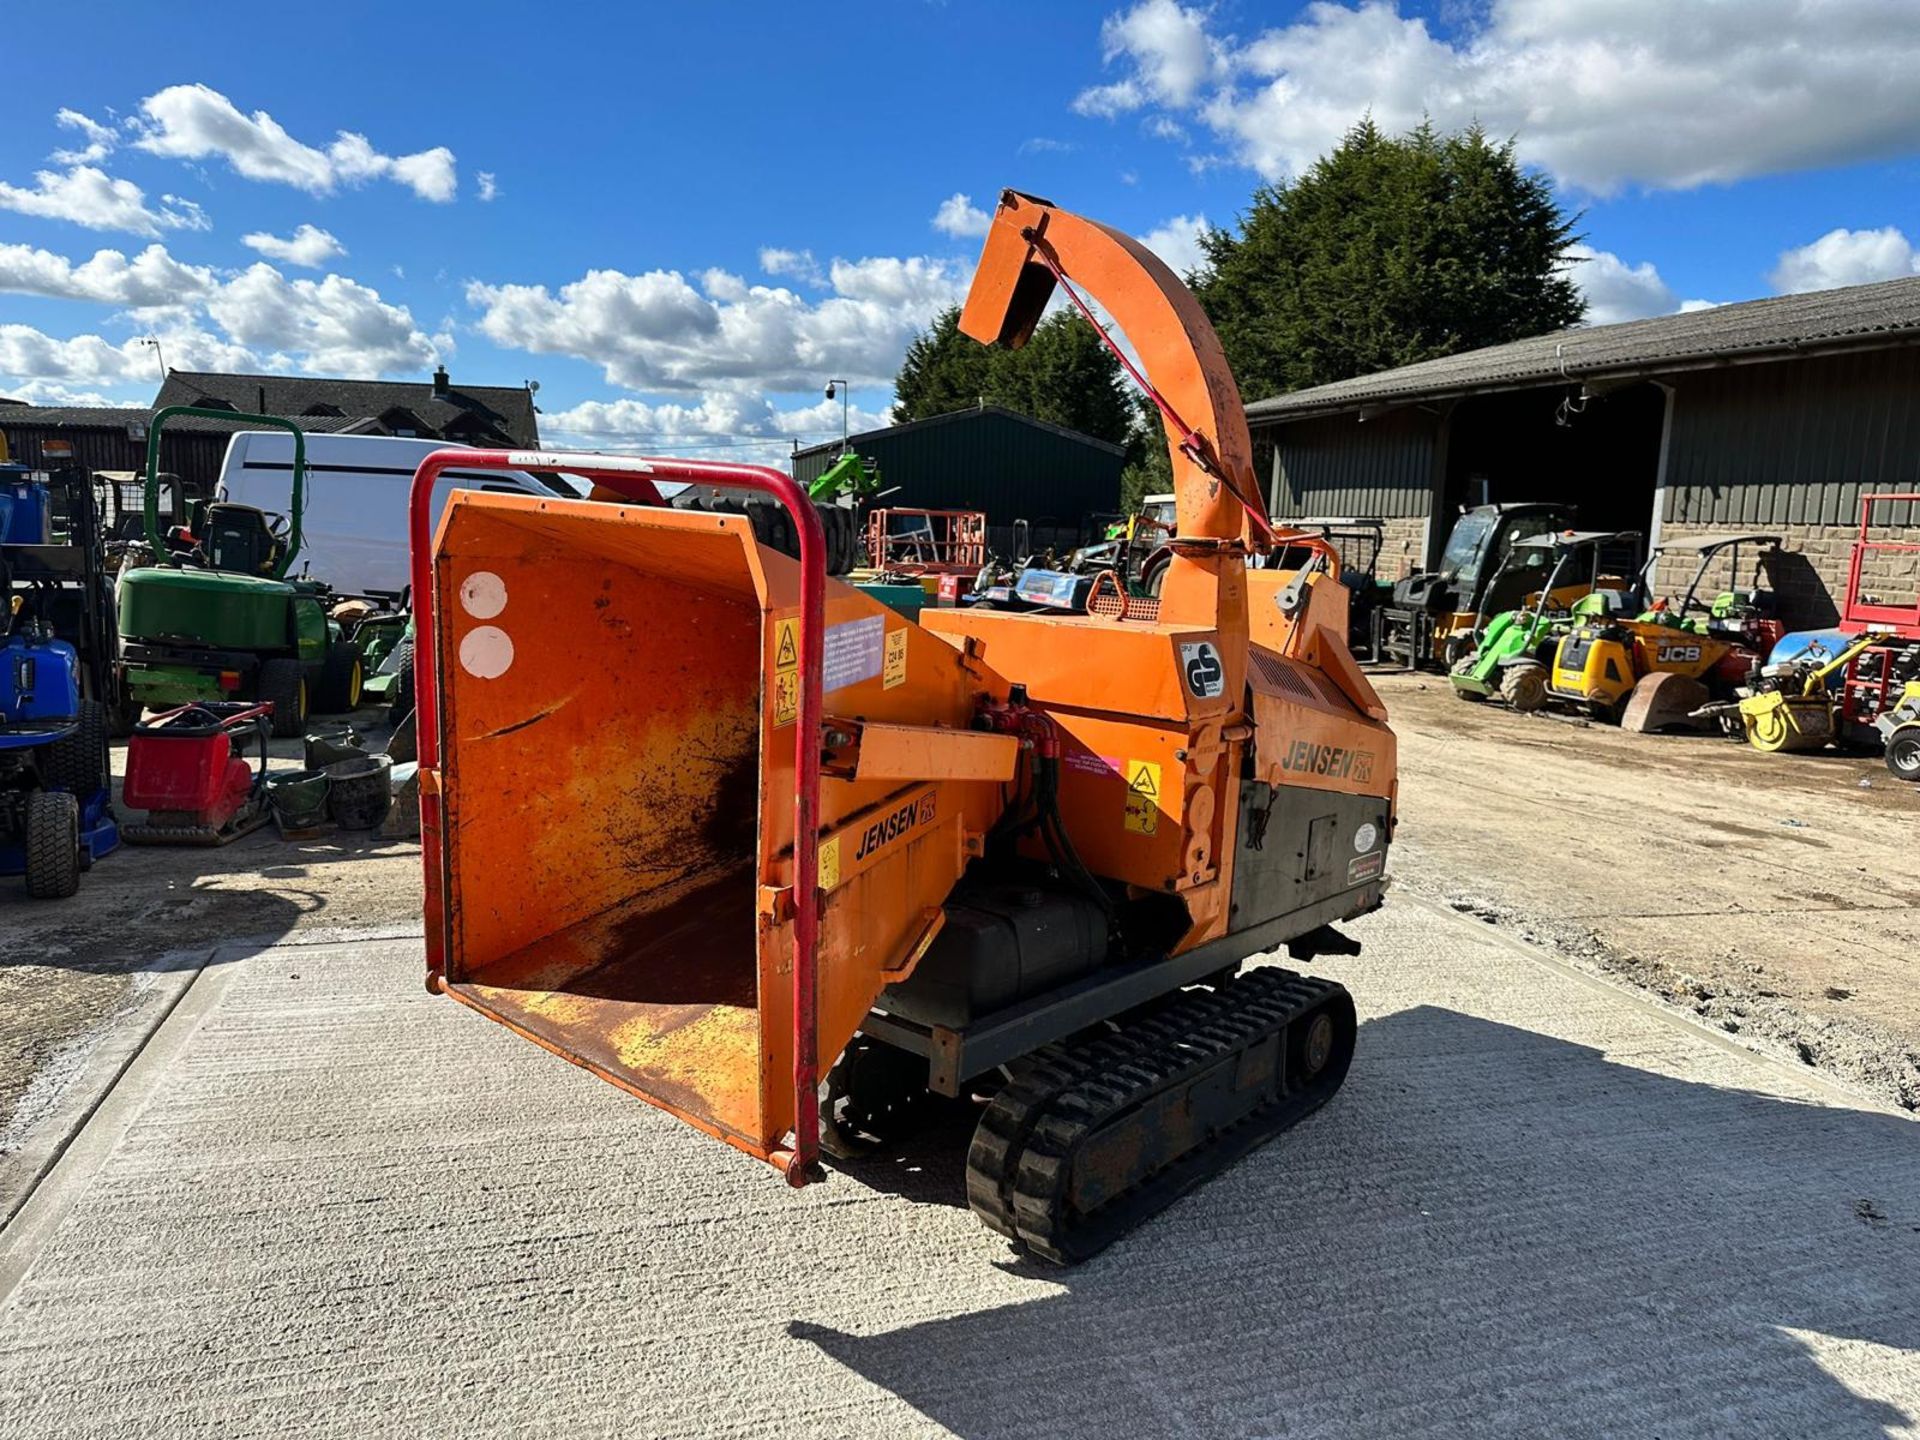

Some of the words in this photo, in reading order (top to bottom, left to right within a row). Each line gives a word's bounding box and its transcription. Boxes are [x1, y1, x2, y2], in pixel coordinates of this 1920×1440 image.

[1658, 647, 1700, 662] JCB
[1282, 740, 1356, 778] JENSEN
[856, 799, 920, 861] JENSEN
